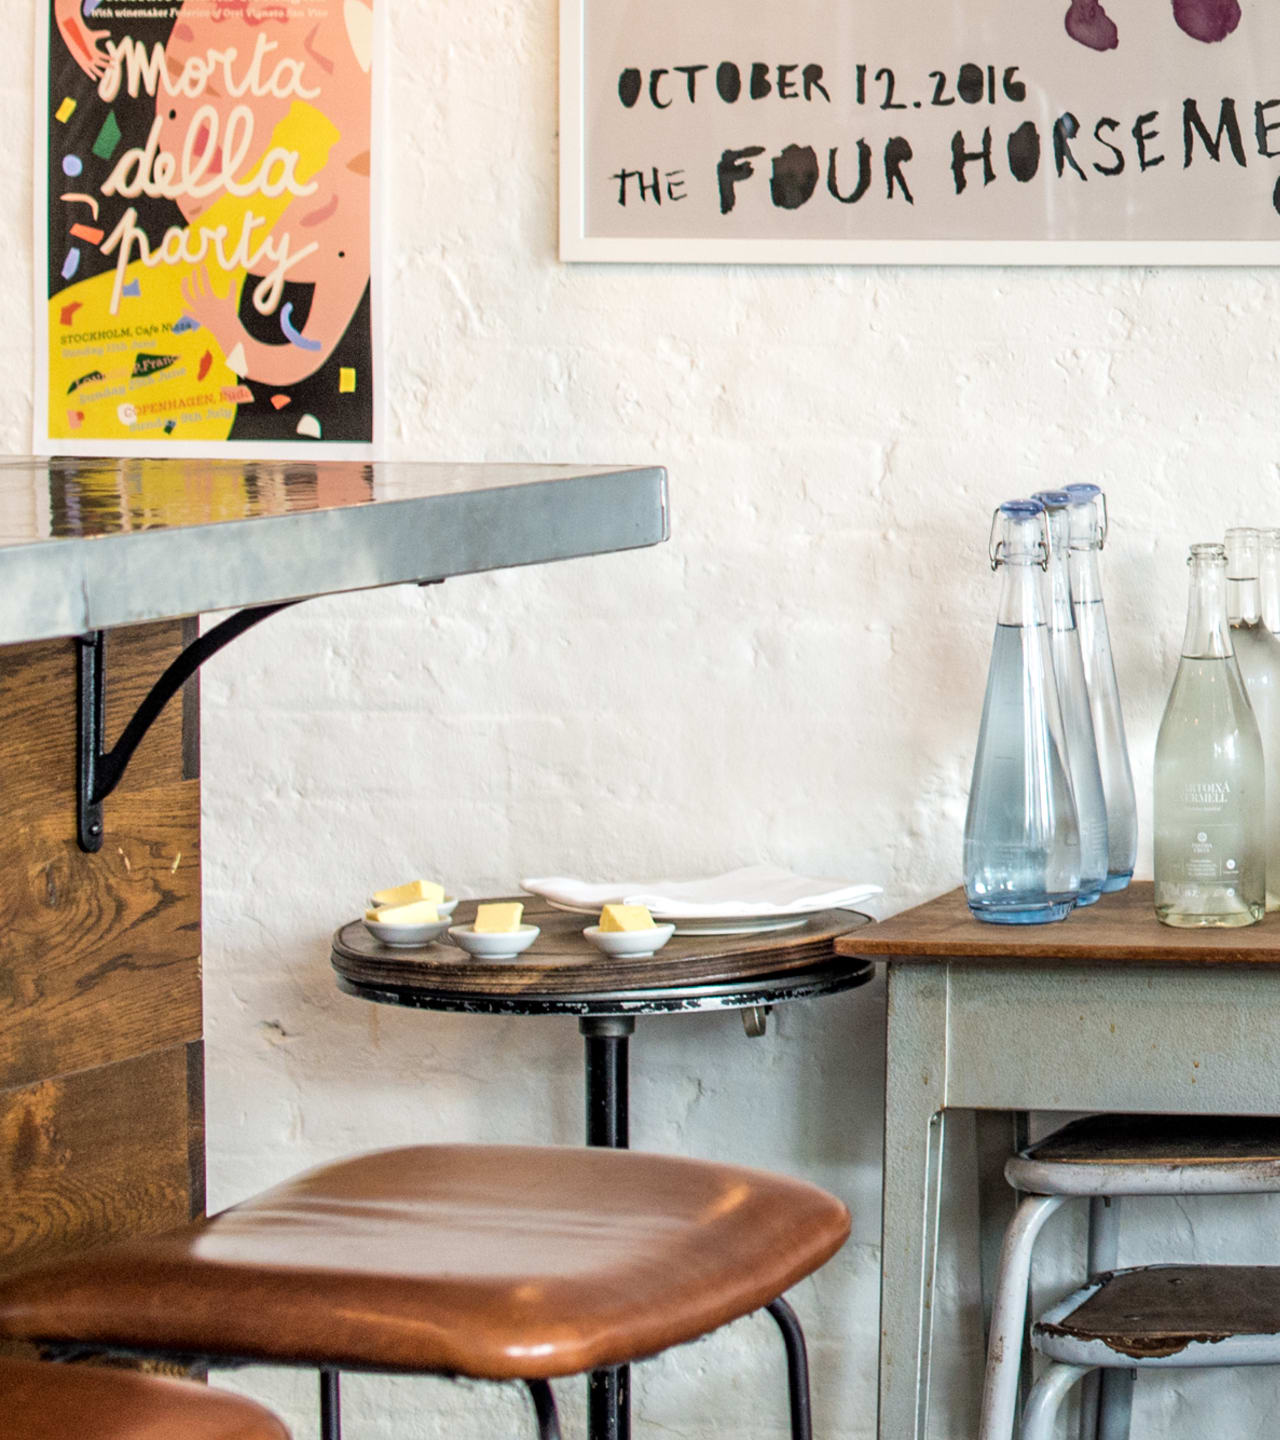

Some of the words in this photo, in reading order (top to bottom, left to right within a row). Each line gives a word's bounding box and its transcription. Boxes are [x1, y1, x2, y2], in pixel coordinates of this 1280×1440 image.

[617, 62, 832, 110] OCTOBER
[855, 63, 1027, 110] 12.2016
[100, 105, 318, 200] della
[610, 166, 688, 207] THE
[716, 135, 915, 215] FOUR
[100, 207, 319, 316] party
[60, 327, 131, 345] STOCKHOLM,
[124, 395, 216, 418] COPENHAGEN,
